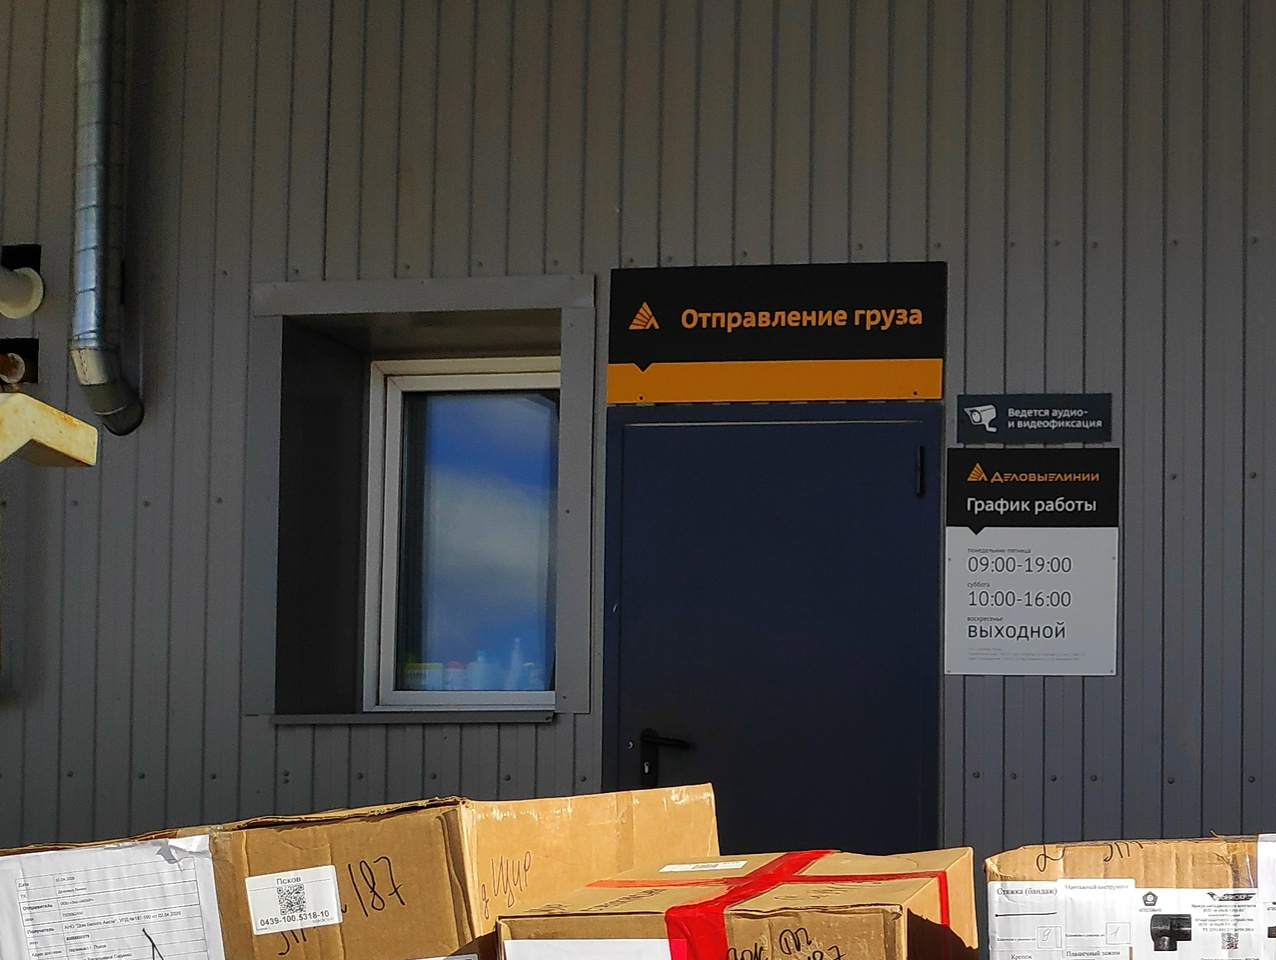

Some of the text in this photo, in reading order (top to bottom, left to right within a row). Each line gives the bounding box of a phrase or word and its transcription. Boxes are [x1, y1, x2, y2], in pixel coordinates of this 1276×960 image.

[680, 308, 923, 333] Отправление груза
[1008, 408, 1089, 419] Ведется аудио-
[1008, 419, 1102, 430] и видеофиксация
[967, 496, 1097, 515] График работы
[968, 556, 1072, 573] 09:00-19:00
[967, 581, 990, 589] суббота
[968, 591, 1072, 608] 10:00-16:00
[276, 877, 302, 886] Псков
[260, 910, 330, 927] 0439-100.5318-10
